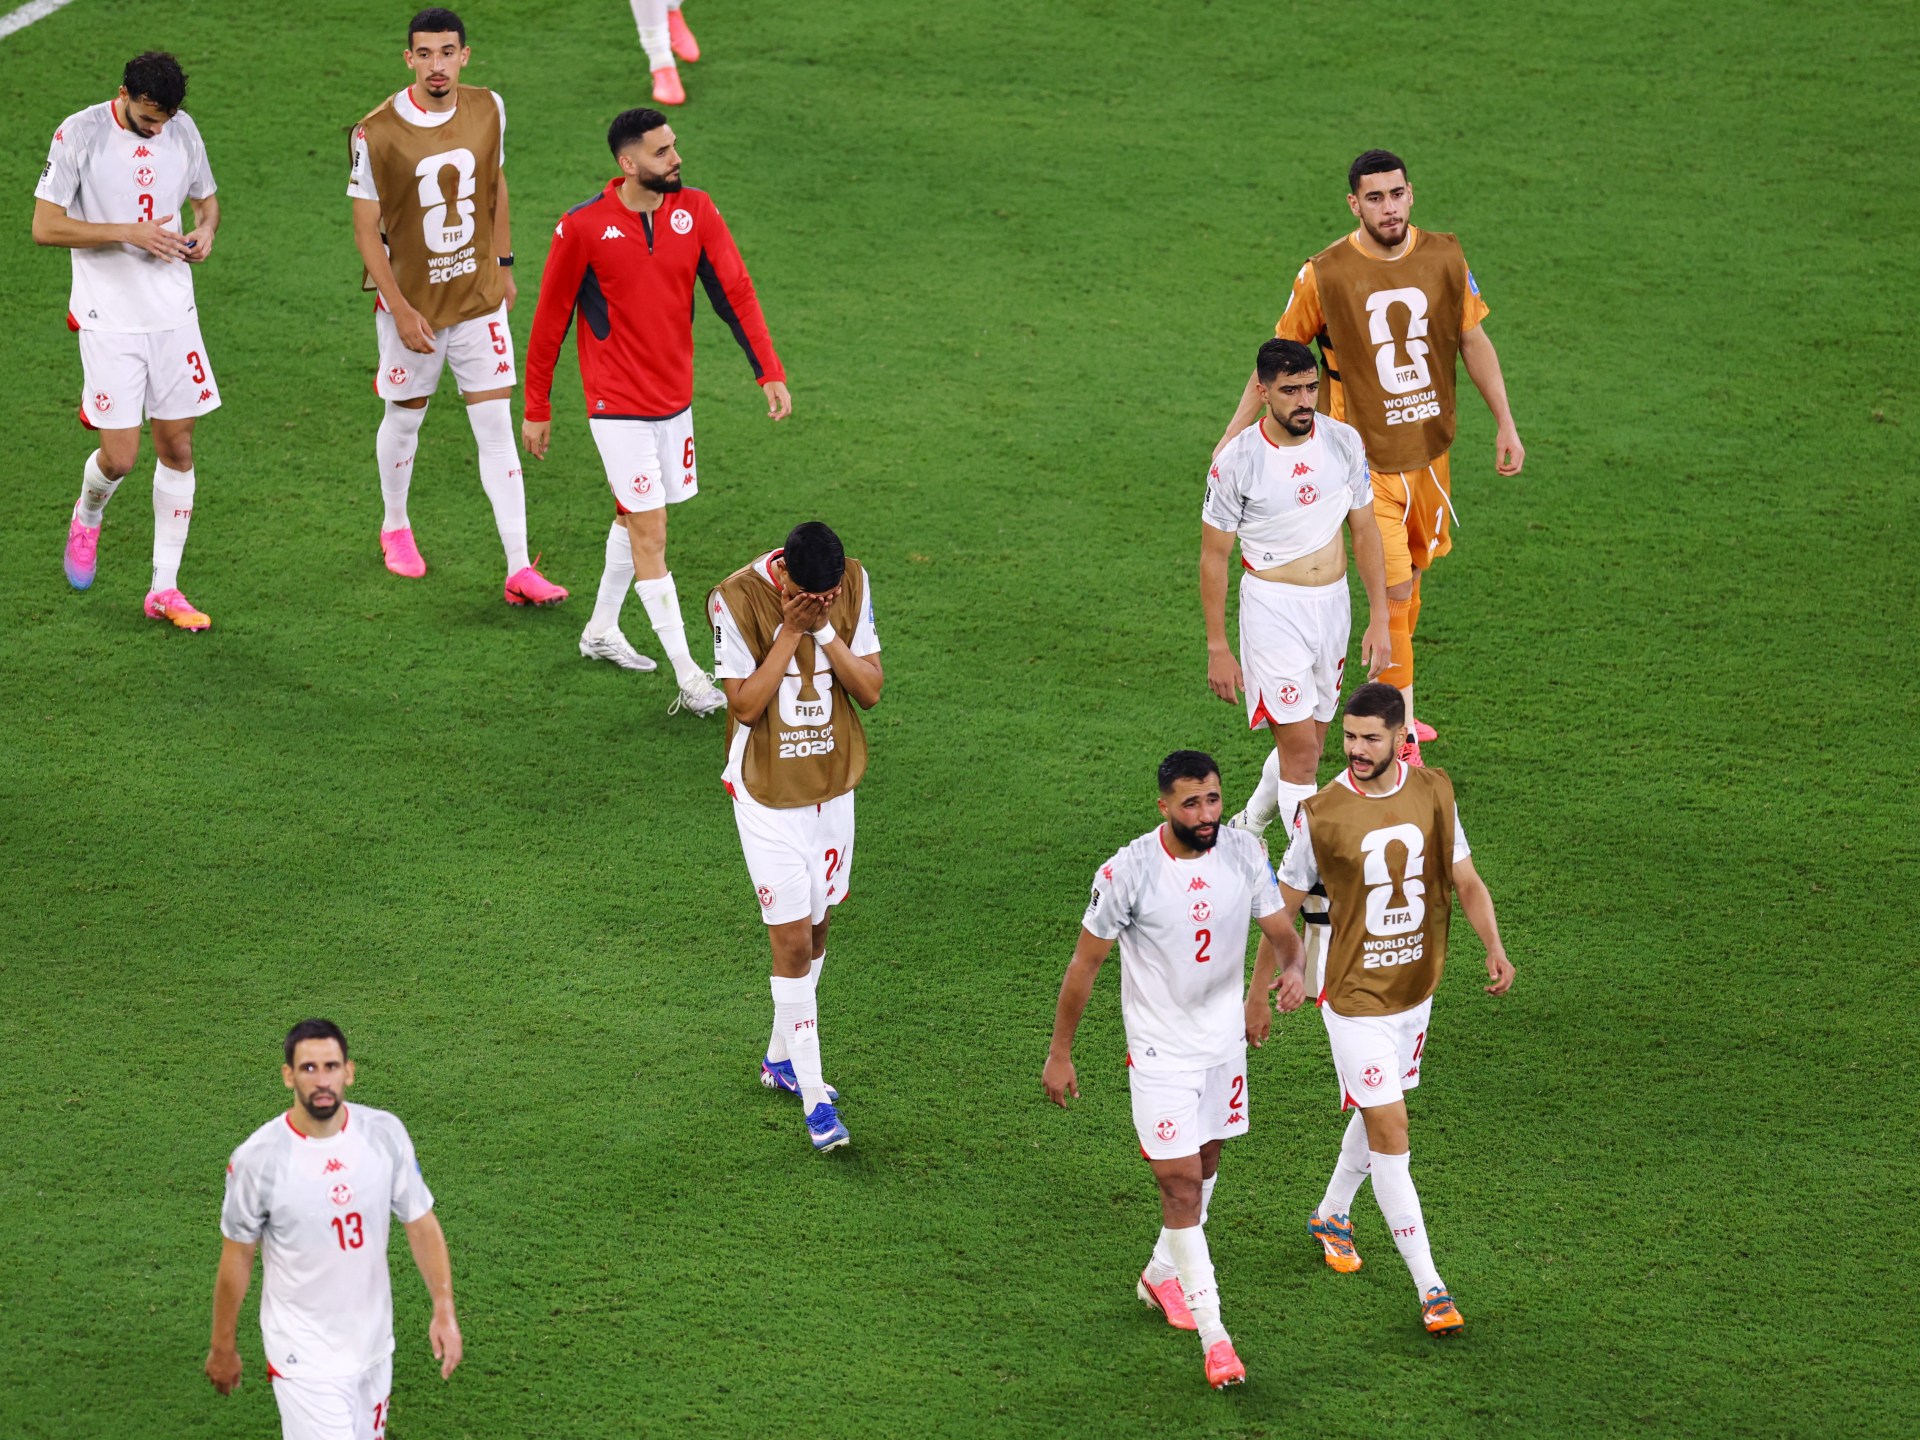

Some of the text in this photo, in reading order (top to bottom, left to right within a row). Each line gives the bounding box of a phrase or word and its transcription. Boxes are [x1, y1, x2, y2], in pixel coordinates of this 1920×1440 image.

[137, 193, 154, 223] 3
[458, 246, 476, 260] CUP
[429, 257, 477, 285] 2026
[488, 321, 507, 355] 5
[187, 350, 206, 385] 3
[1395, 369, 1419, 384] FIFA
[1383, 389, 1437, 409] WORLD CUP
[1385, 401, 1441, 426] 2026
[683, 436, 694, 469] 6
[795, 705, 824, 717] FIFA
[779, 724, 834, 742] WORLD CUP
[779, 735, 835, 759] 2026
[1383, 912, 1412, 926] FIFA
[1195, 928, 1211, 963] 2
[1363, 932, 1424, 951] WORLD CUP
[1363, 944, 1424, 969] 2026
[1229, 1074, 1243, 1109] 2
[331, 1211, 364, 1251] 13
[1393, 1226, 1416, 1238] FTF
